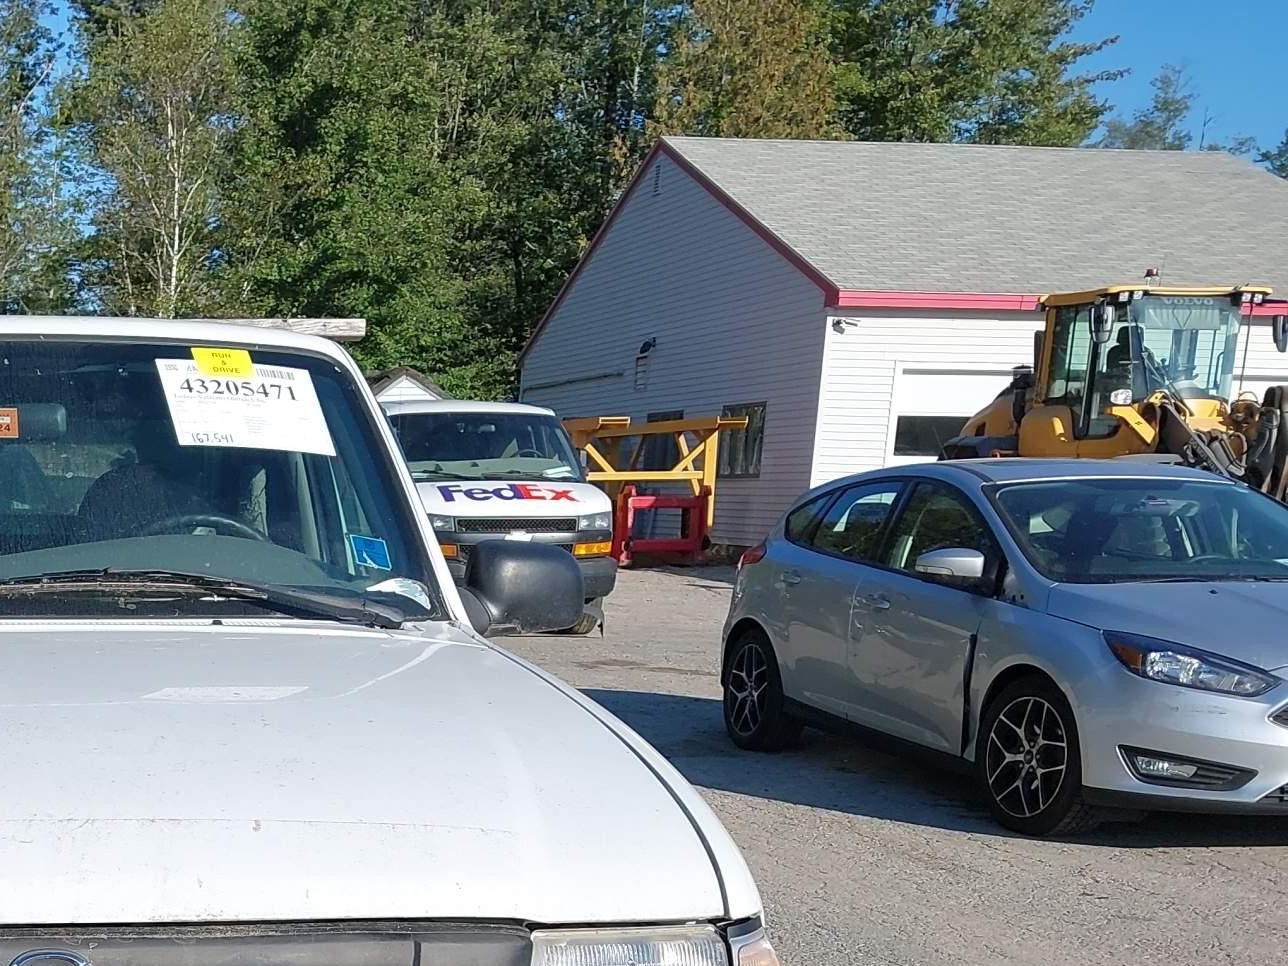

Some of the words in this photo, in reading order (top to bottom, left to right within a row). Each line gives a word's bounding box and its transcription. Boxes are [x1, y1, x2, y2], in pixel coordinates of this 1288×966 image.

[1162, 297, 1214, 305] VOLVO
[179, 378, 297, 401] 43205471
[436, 483, 580, 502] FedEx
